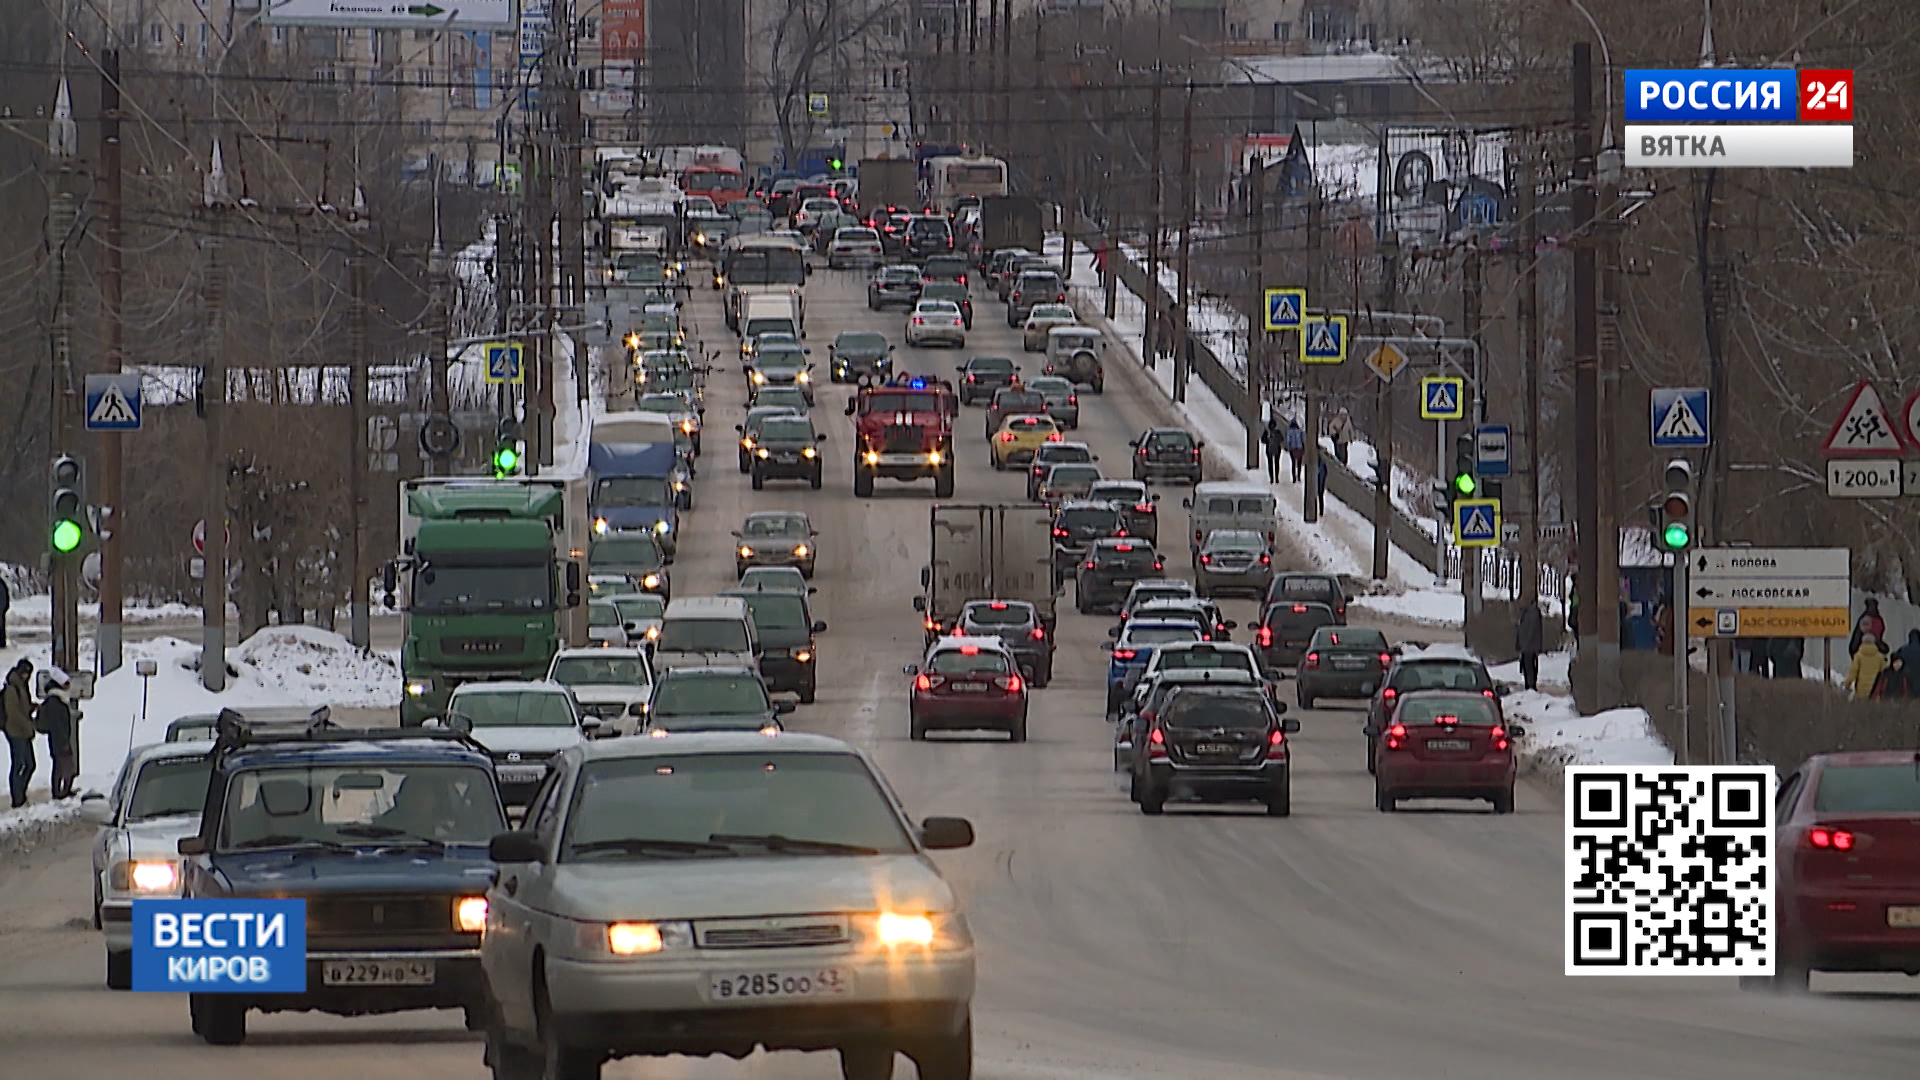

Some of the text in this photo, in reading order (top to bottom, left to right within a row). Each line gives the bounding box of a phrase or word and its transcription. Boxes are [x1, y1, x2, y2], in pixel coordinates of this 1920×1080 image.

[1845, 469, 1879, 488] 200
[1731, 557, 1777, 568] ПОПОВА
[1731, 586, 1810, 599] МОСКОВСКАЯ
